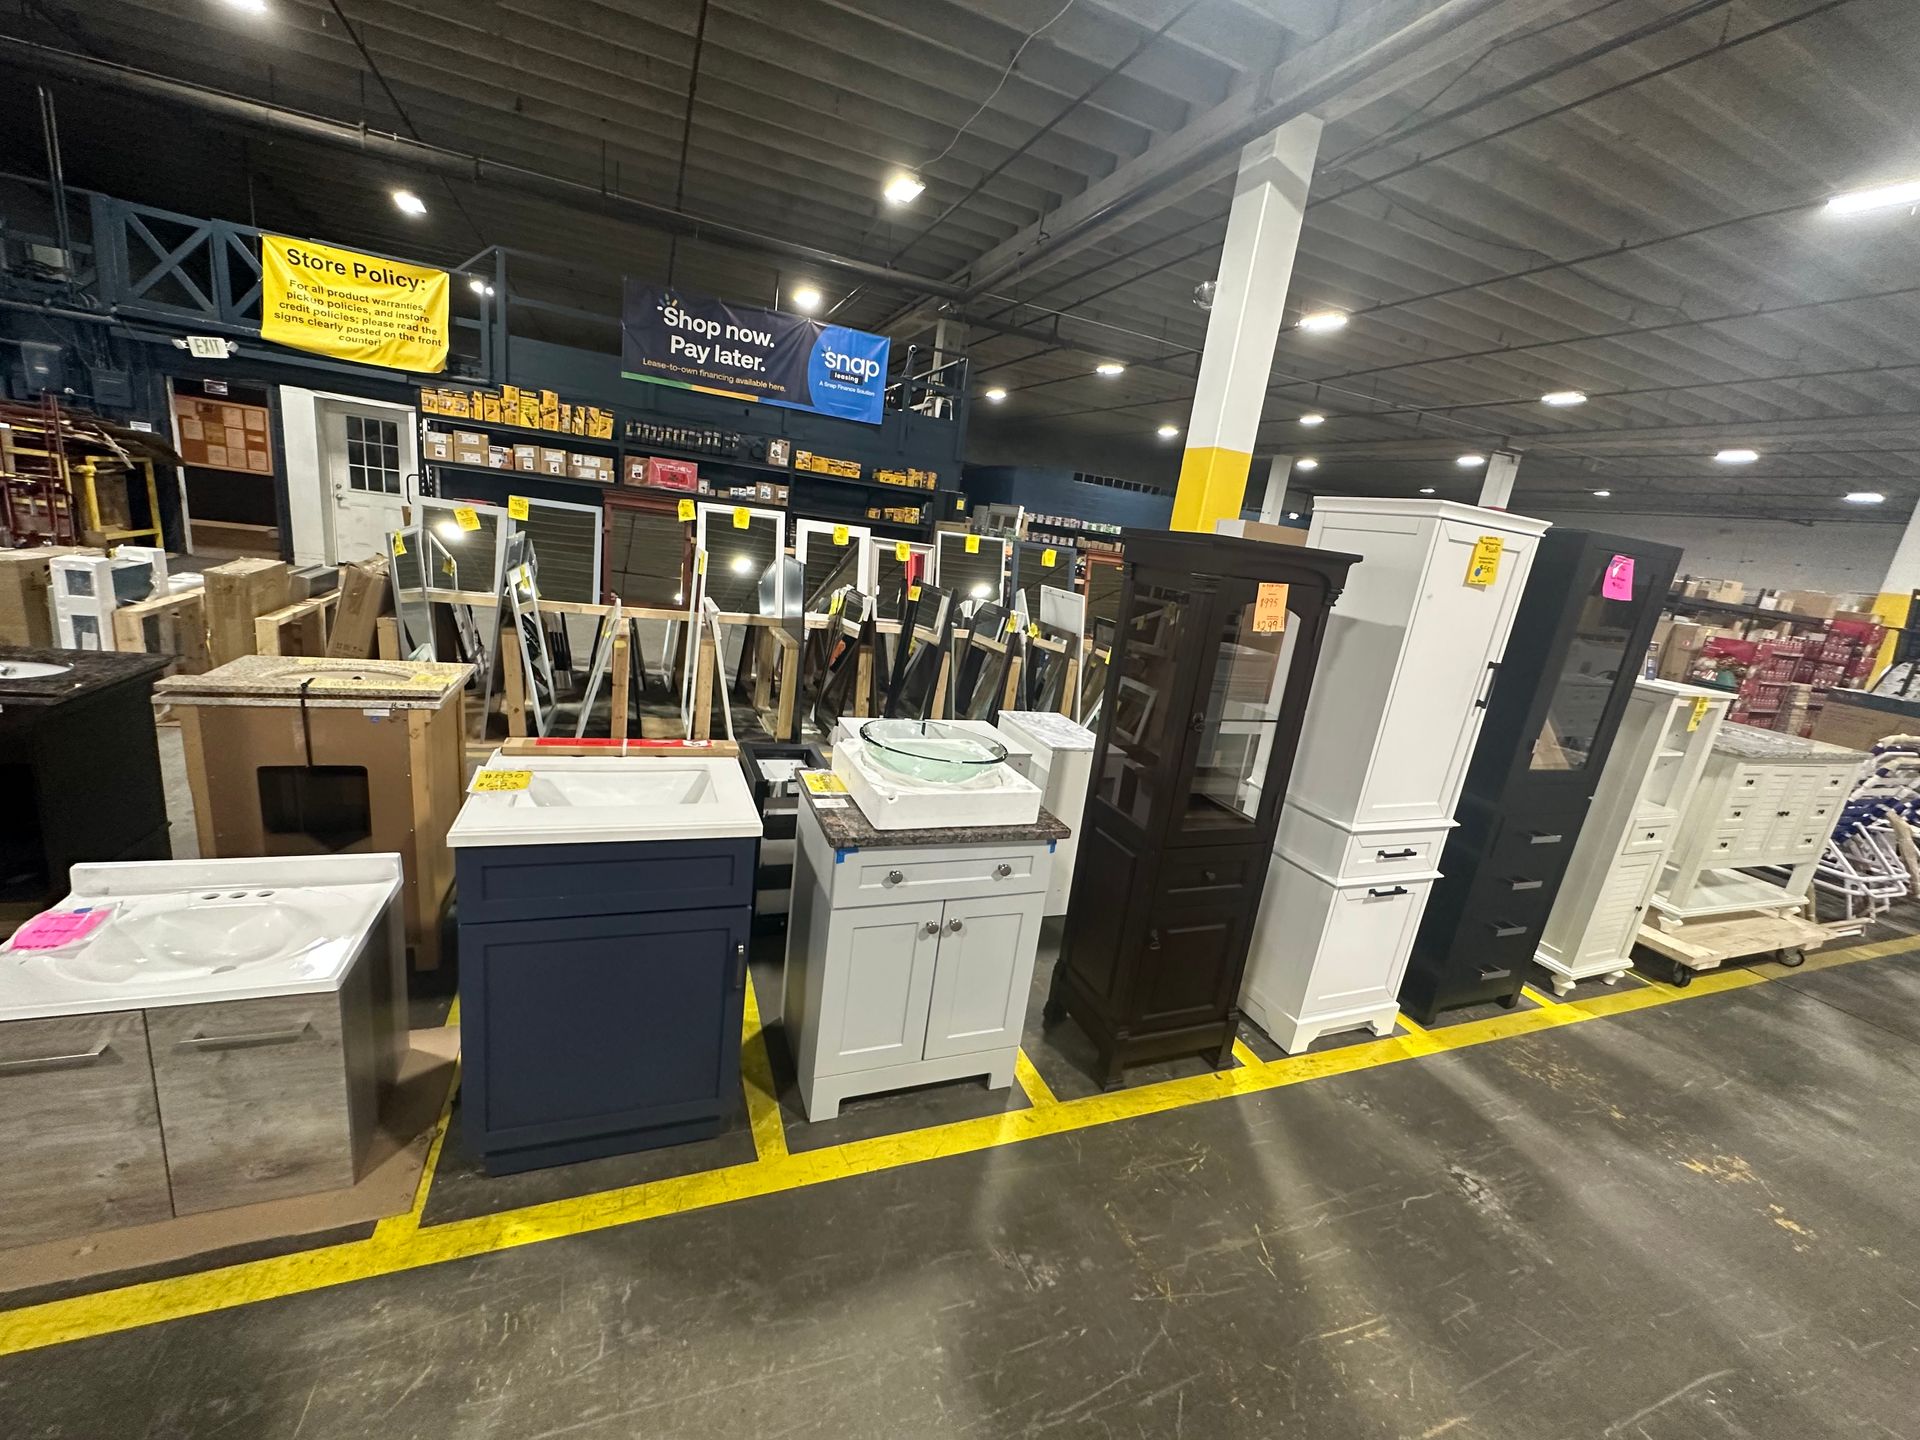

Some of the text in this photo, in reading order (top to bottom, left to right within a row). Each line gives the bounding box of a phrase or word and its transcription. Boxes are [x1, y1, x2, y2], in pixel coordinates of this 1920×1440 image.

[287, 248, 426, 293] Store Policy:
[286, 291, 430, 324] pickup policies, and instore
[289, 280, 427, 312] For all product warranties,
[274, 311, 442, 347] signs clearly posted on the front
[279, 301, 437, 336] credit policies; please read the
[663, 306, 775, 348] Shop now.
[193, 338, 221, 354] EXIT
[338, 334, 382, 347] counter!
[670, 335, 766, 372] Pay later.
[642, 357, 787, 392] Lease-to-own financing available here.
[824, 351, 880, 383] snap
[834, 372, 859, 384] leasing
[824, 381, 837, 389] Snap
